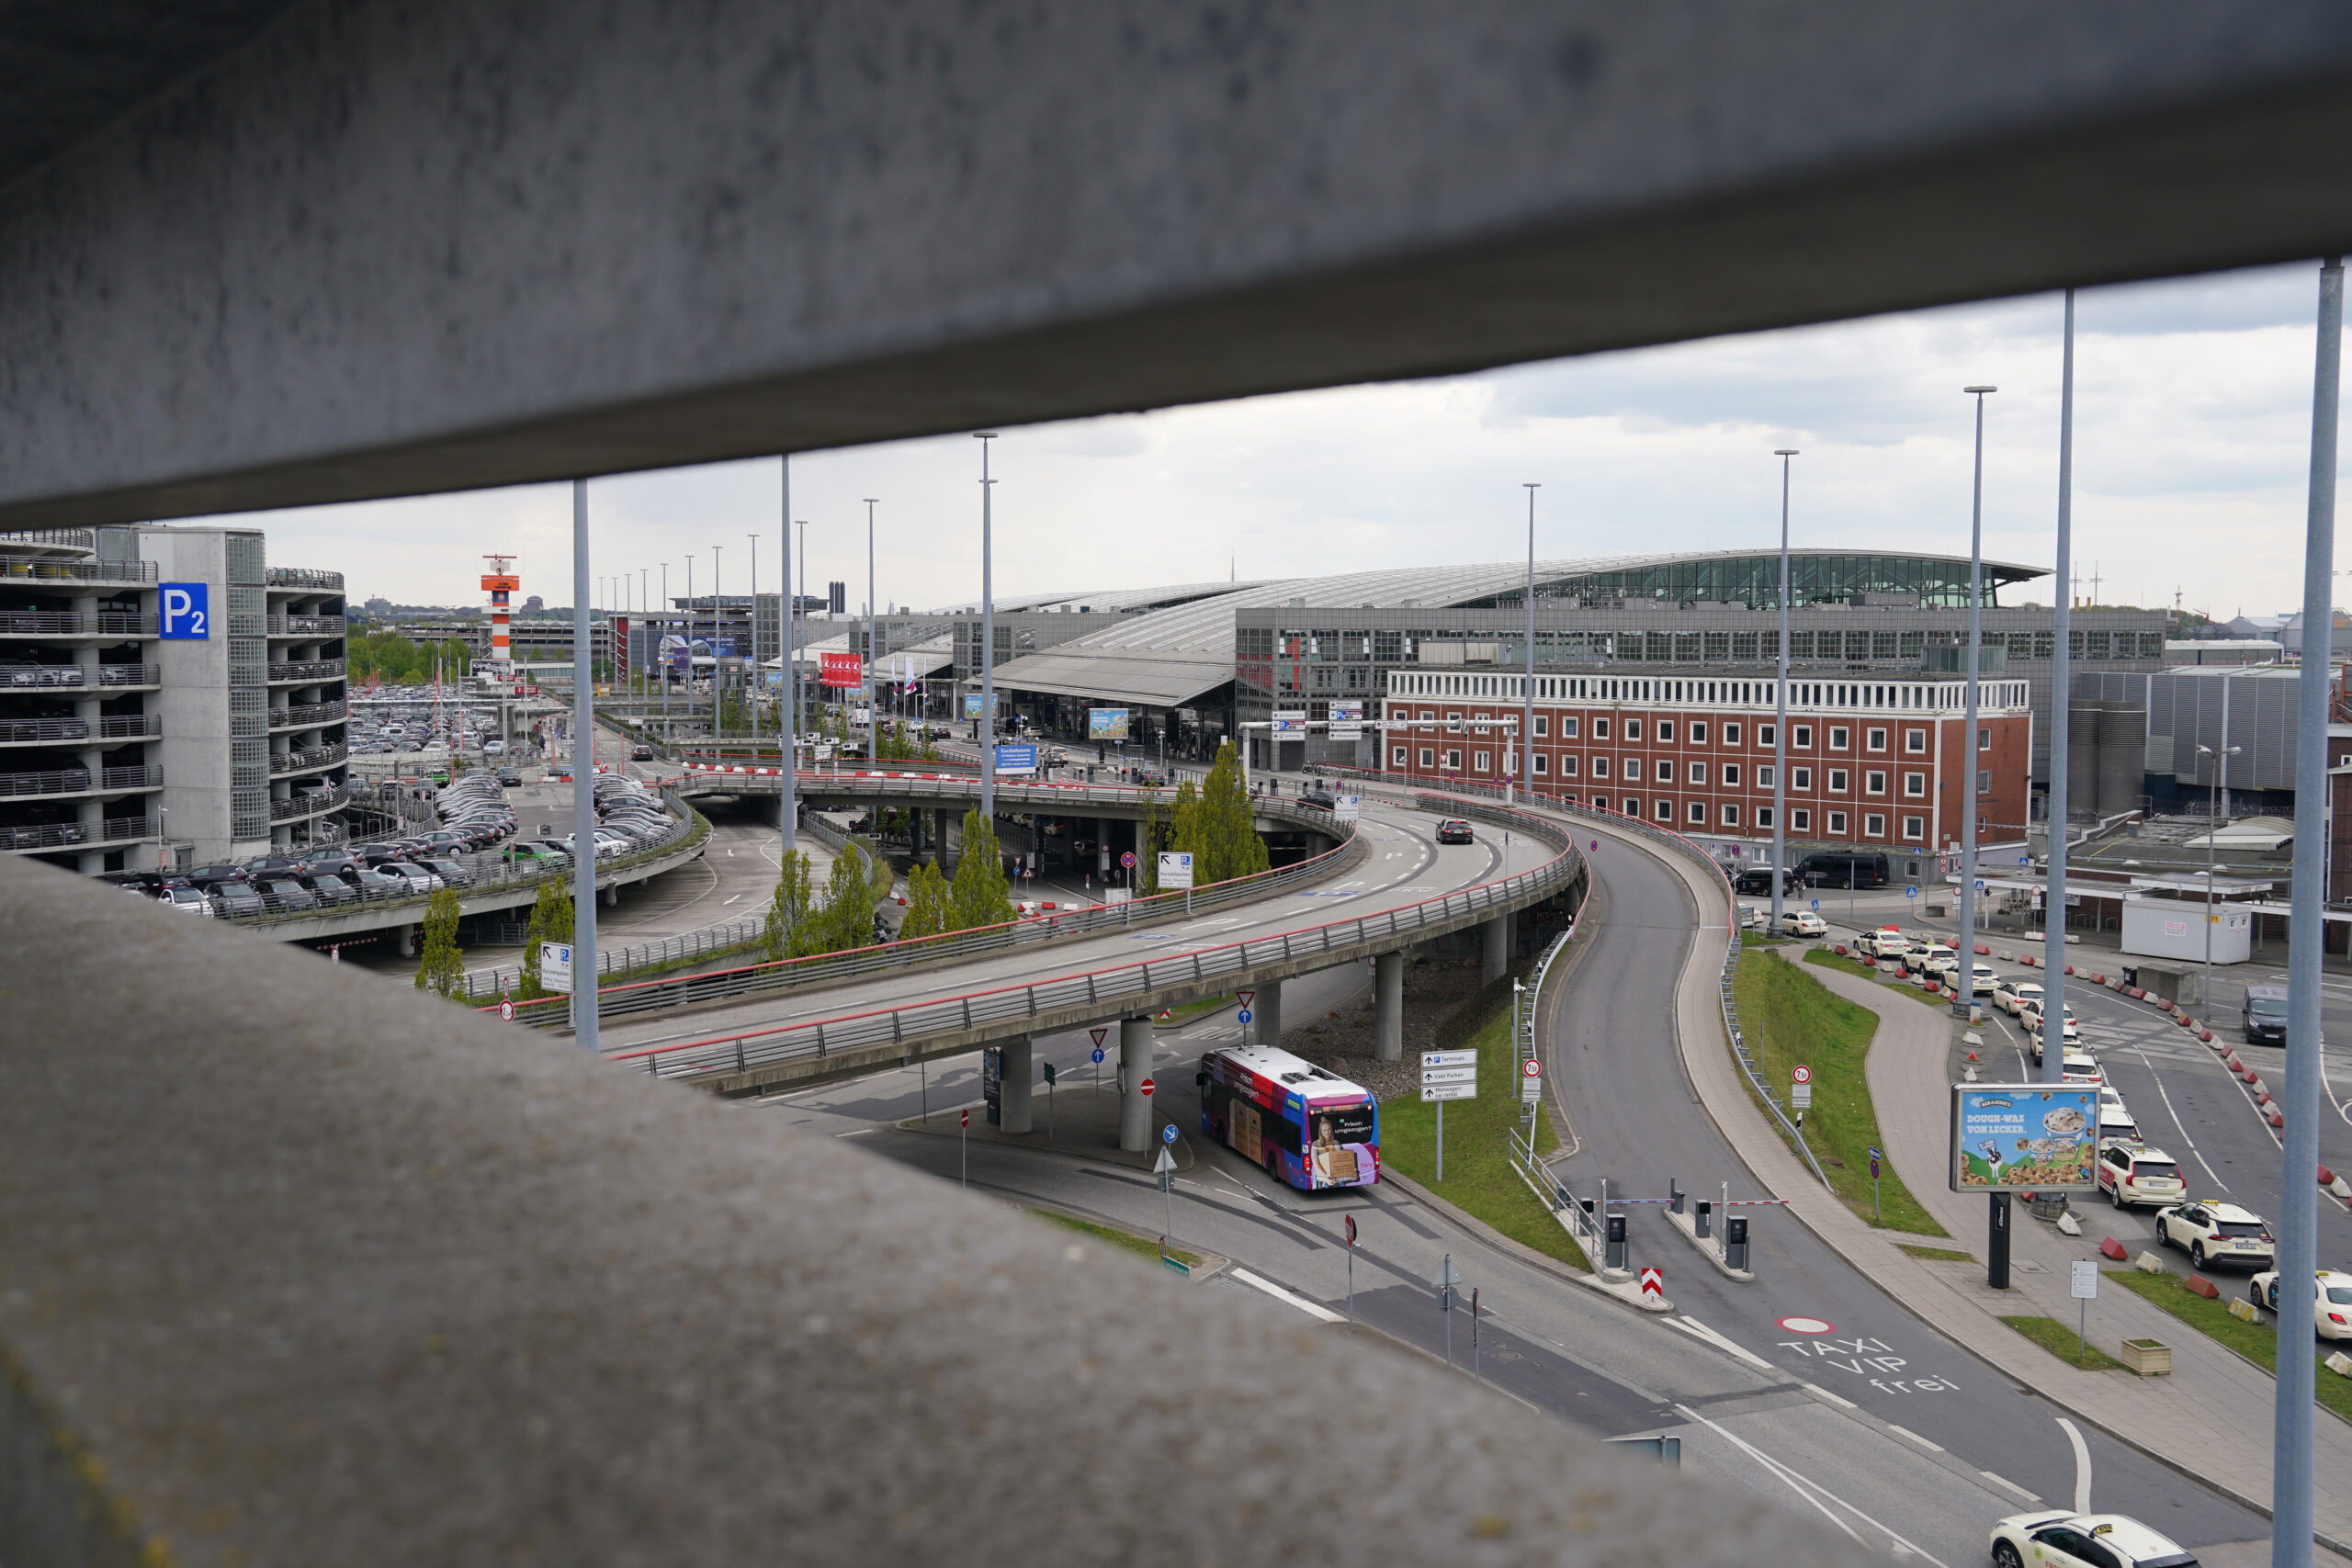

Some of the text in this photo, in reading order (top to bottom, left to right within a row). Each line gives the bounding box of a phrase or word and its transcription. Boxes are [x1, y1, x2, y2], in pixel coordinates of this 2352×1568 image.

[164, 589, 205, 634] P2
[1240, 1072, 1253, 1087] Frisch
[1967, 1114, 2025, 1123] DOUGH-WAS
[1335, 1126, 1372, 1134] umgezogen?
[1967, 1125, 2027, 1134] VON LECKER.
[1777, 1337, 1895, 1357] TAXI
[1825, 1356, 1907, 1374] VIP
[1869, 1374, 1962, 1394] frei
